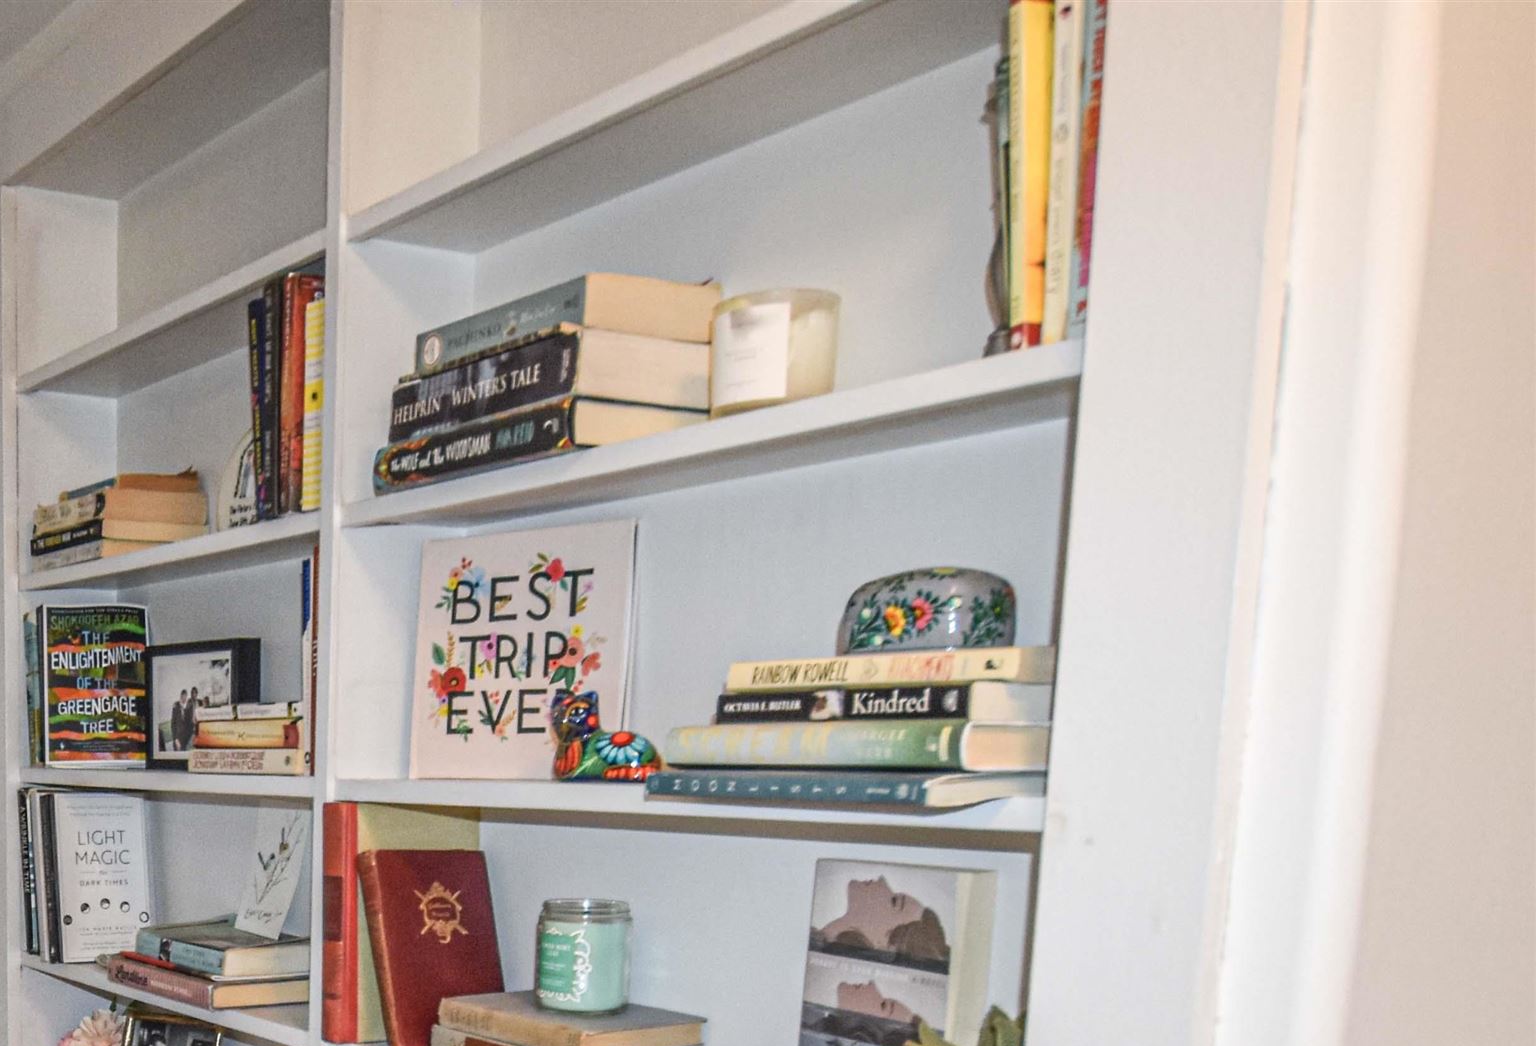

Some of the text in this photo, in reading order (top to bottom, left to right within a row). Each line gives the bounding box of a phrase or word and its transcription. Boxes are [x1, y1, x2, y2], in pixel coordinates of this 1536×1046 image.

[393, 395, 440, 425] HELPRIN
[511, 363, 542, 388] TALE
[450, 567, 595, 625] BEST
[81, 630, 111, 646] THE
[51, 646, 142, 670] ENLIGHTENMENT
[459, 631, 568, 680] TRIP
[76, 677, 118, 690] OF THE
[752, 661, 850, 685] RAINBOW ROWELL
[58, 696, 137, 716] GREENGAGE
[446, 688, 548, 735] EVE
[851, 686, 931, 716] Kindred
[80, 719, 114, 734] TREE
[77, 829, 127, 846] LIGHT
[74, 849, 131, 866] MAGIC
[79, 878, 130, 887] DARK TIMES
